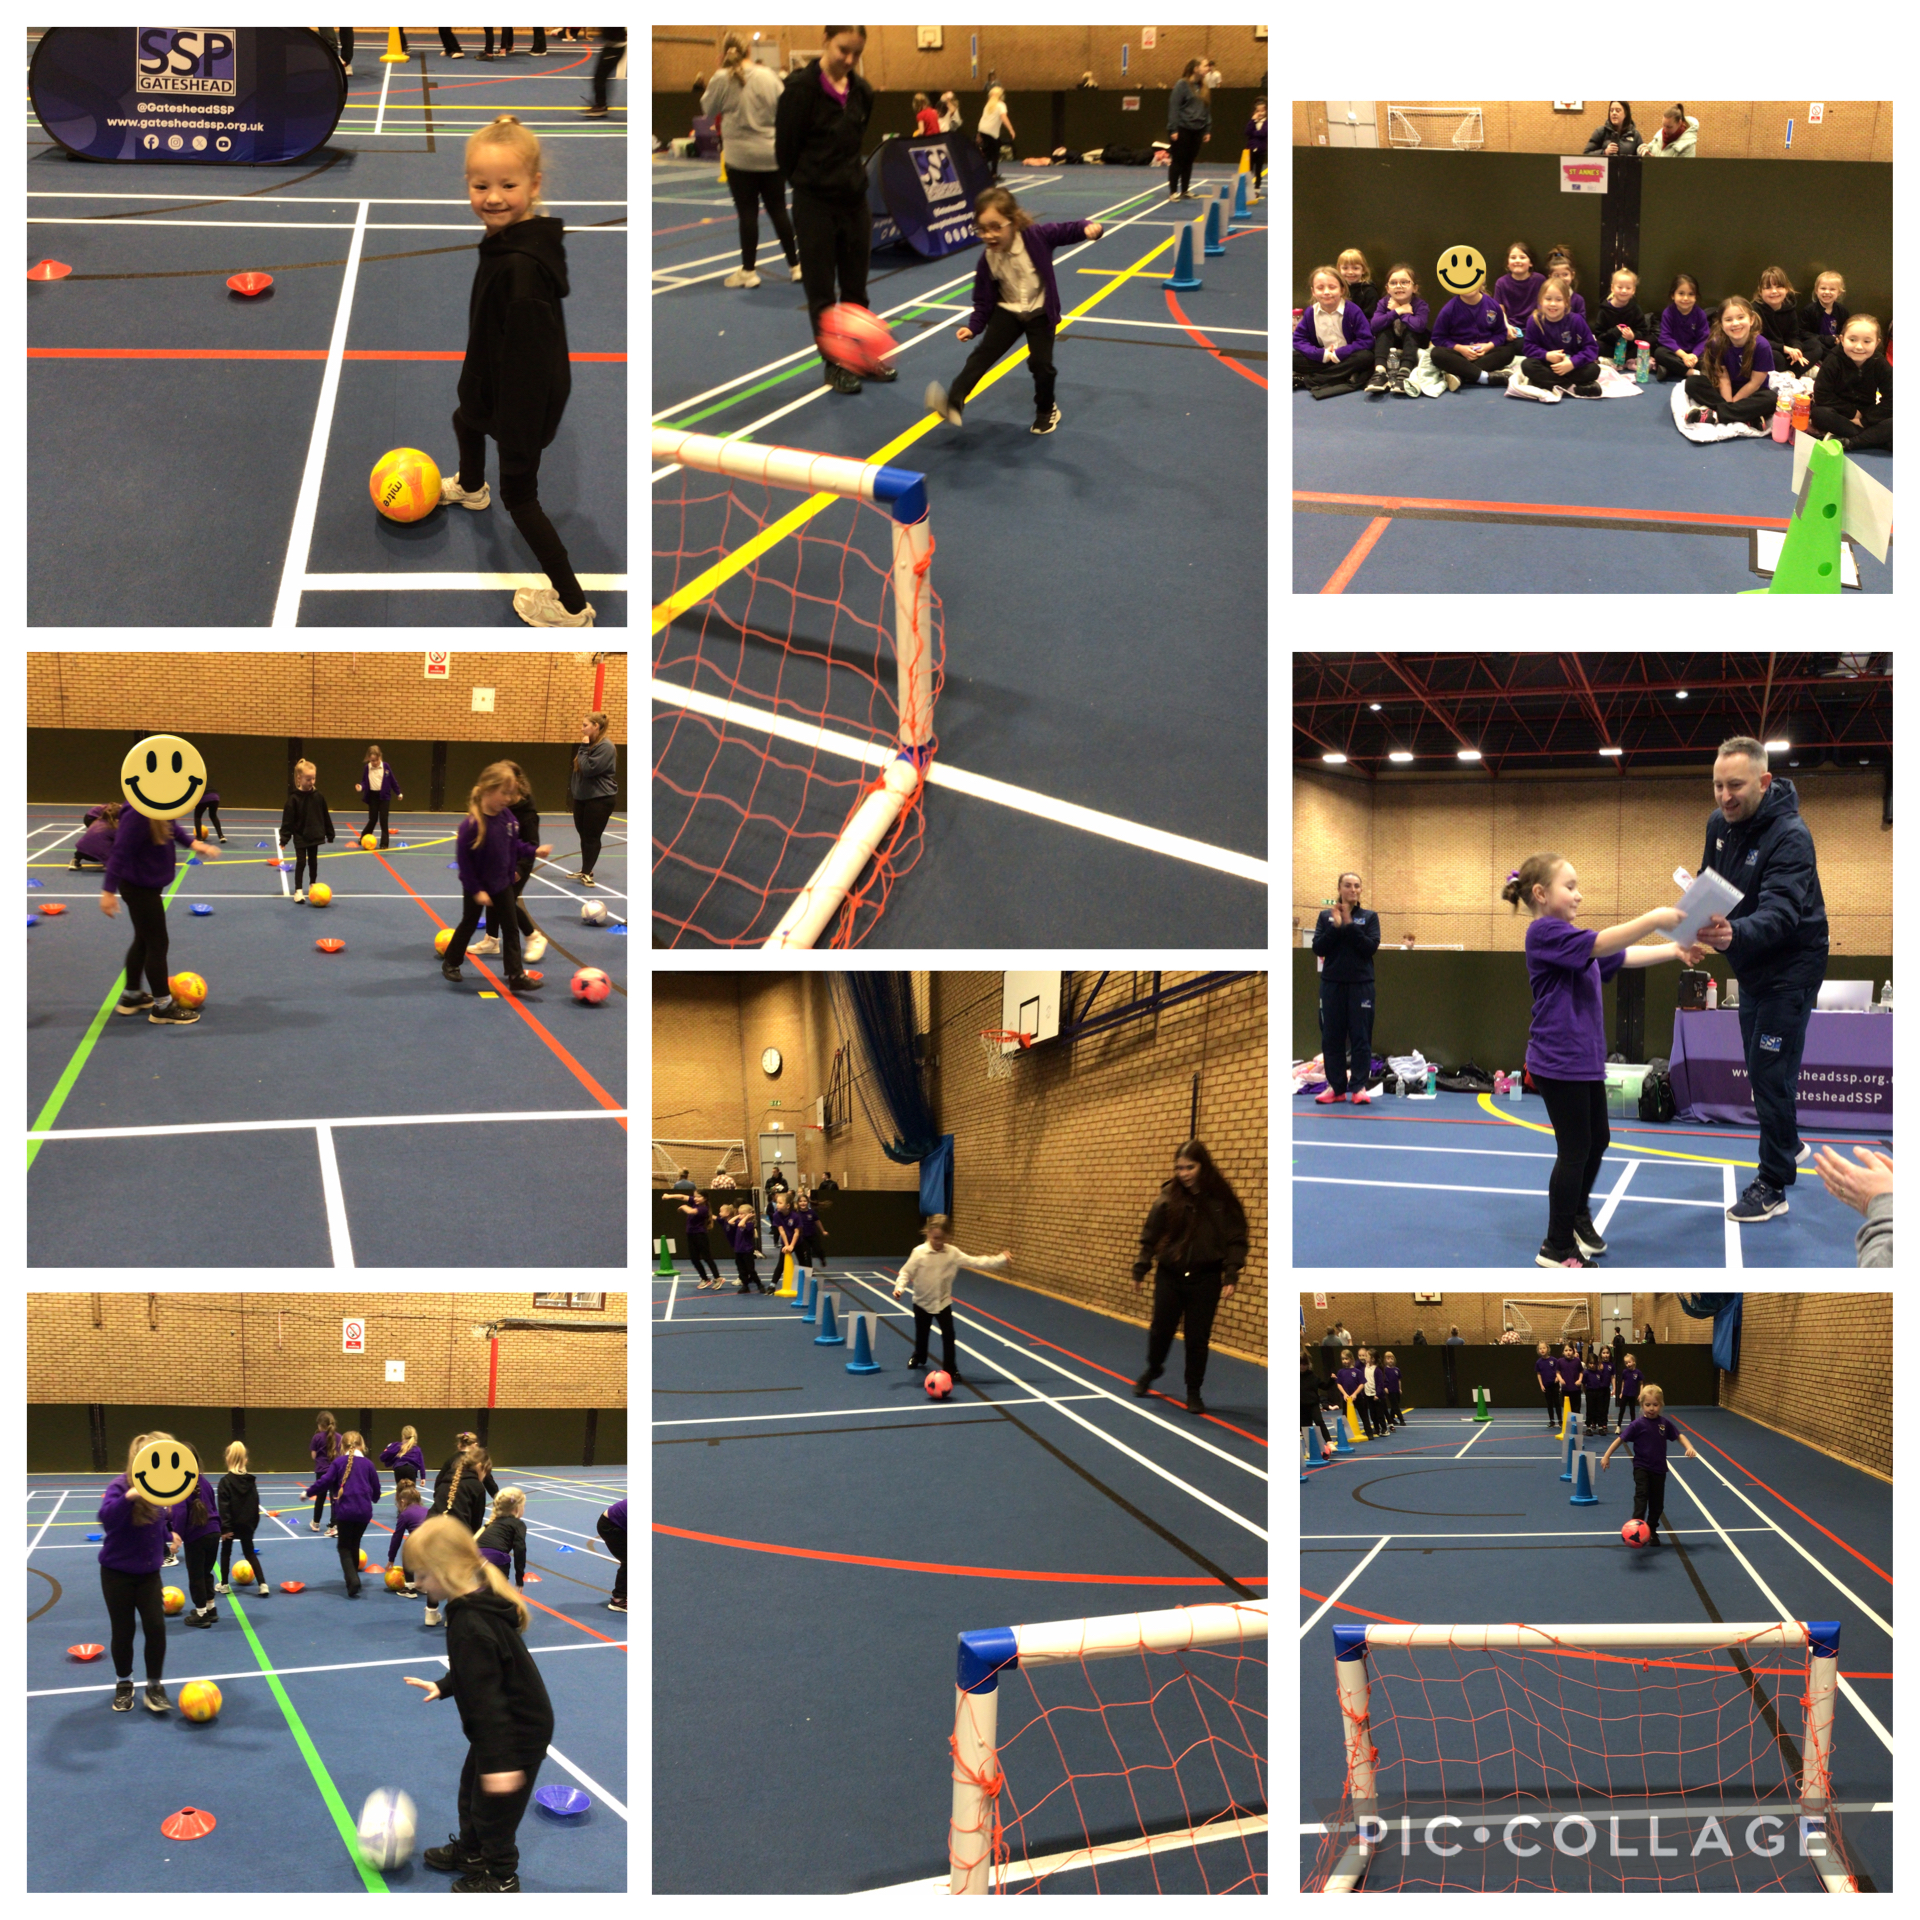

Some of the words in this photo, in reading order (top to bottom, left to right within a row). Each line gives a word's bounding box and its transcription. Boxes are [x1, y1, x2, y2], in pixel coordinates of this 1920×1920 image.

[140, 29, 233, 77] SSP
[140, 77, 232, 93] GATESHEAD
[137, 102, 235, 115] @GatesheadSSP
[107, 118, 264, 133] www.gatesheadssp.org.uk
[1578, 168, 1600, 176] ANNE'S
[383, 481, 402, 507] mitre
[1760, 1035, 1782, 1049] SSP
[1795, 1090, 1883, 1104] atesheadSSP
